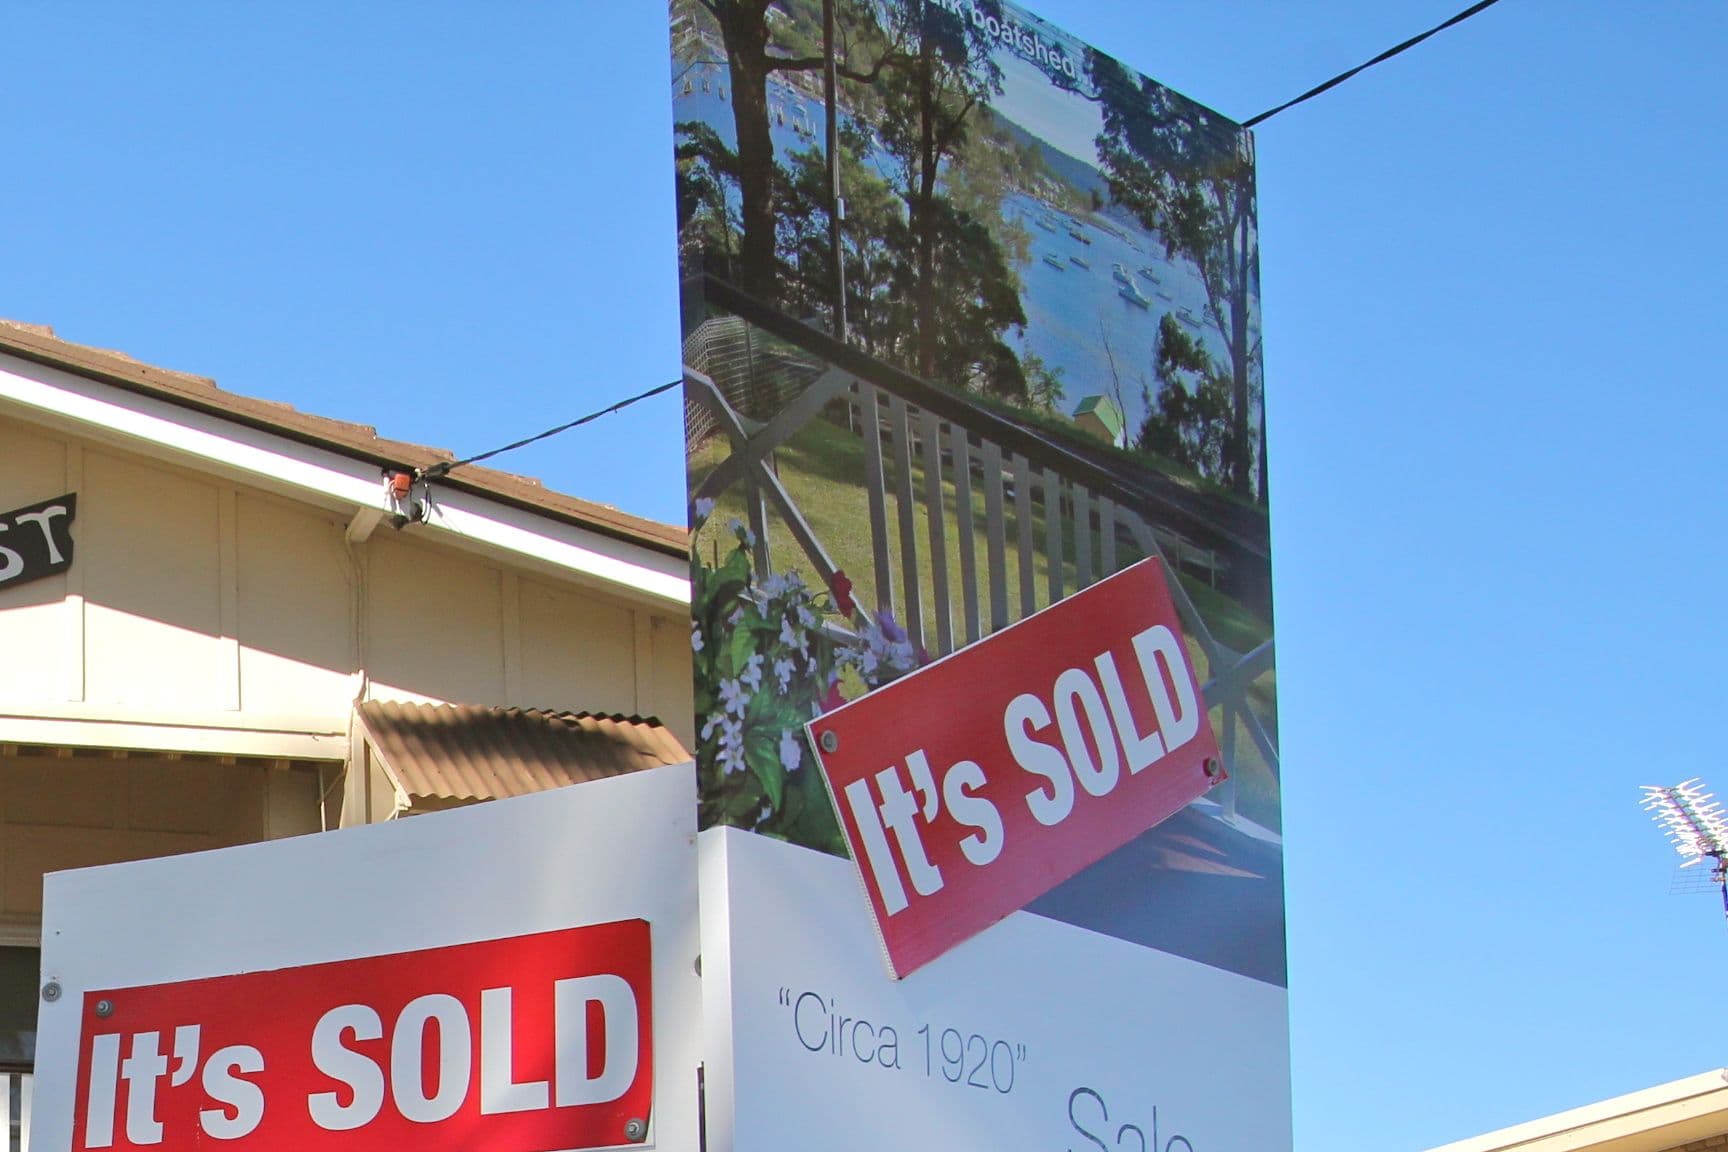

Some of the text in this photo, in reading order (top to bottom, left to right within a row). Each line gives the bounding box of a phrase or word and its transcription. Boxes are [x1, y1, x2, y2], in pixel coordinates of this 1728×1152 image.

[844, 624, 1199, 916] It's SOLD
[84, 974, 639, 1149] It's SOLD
